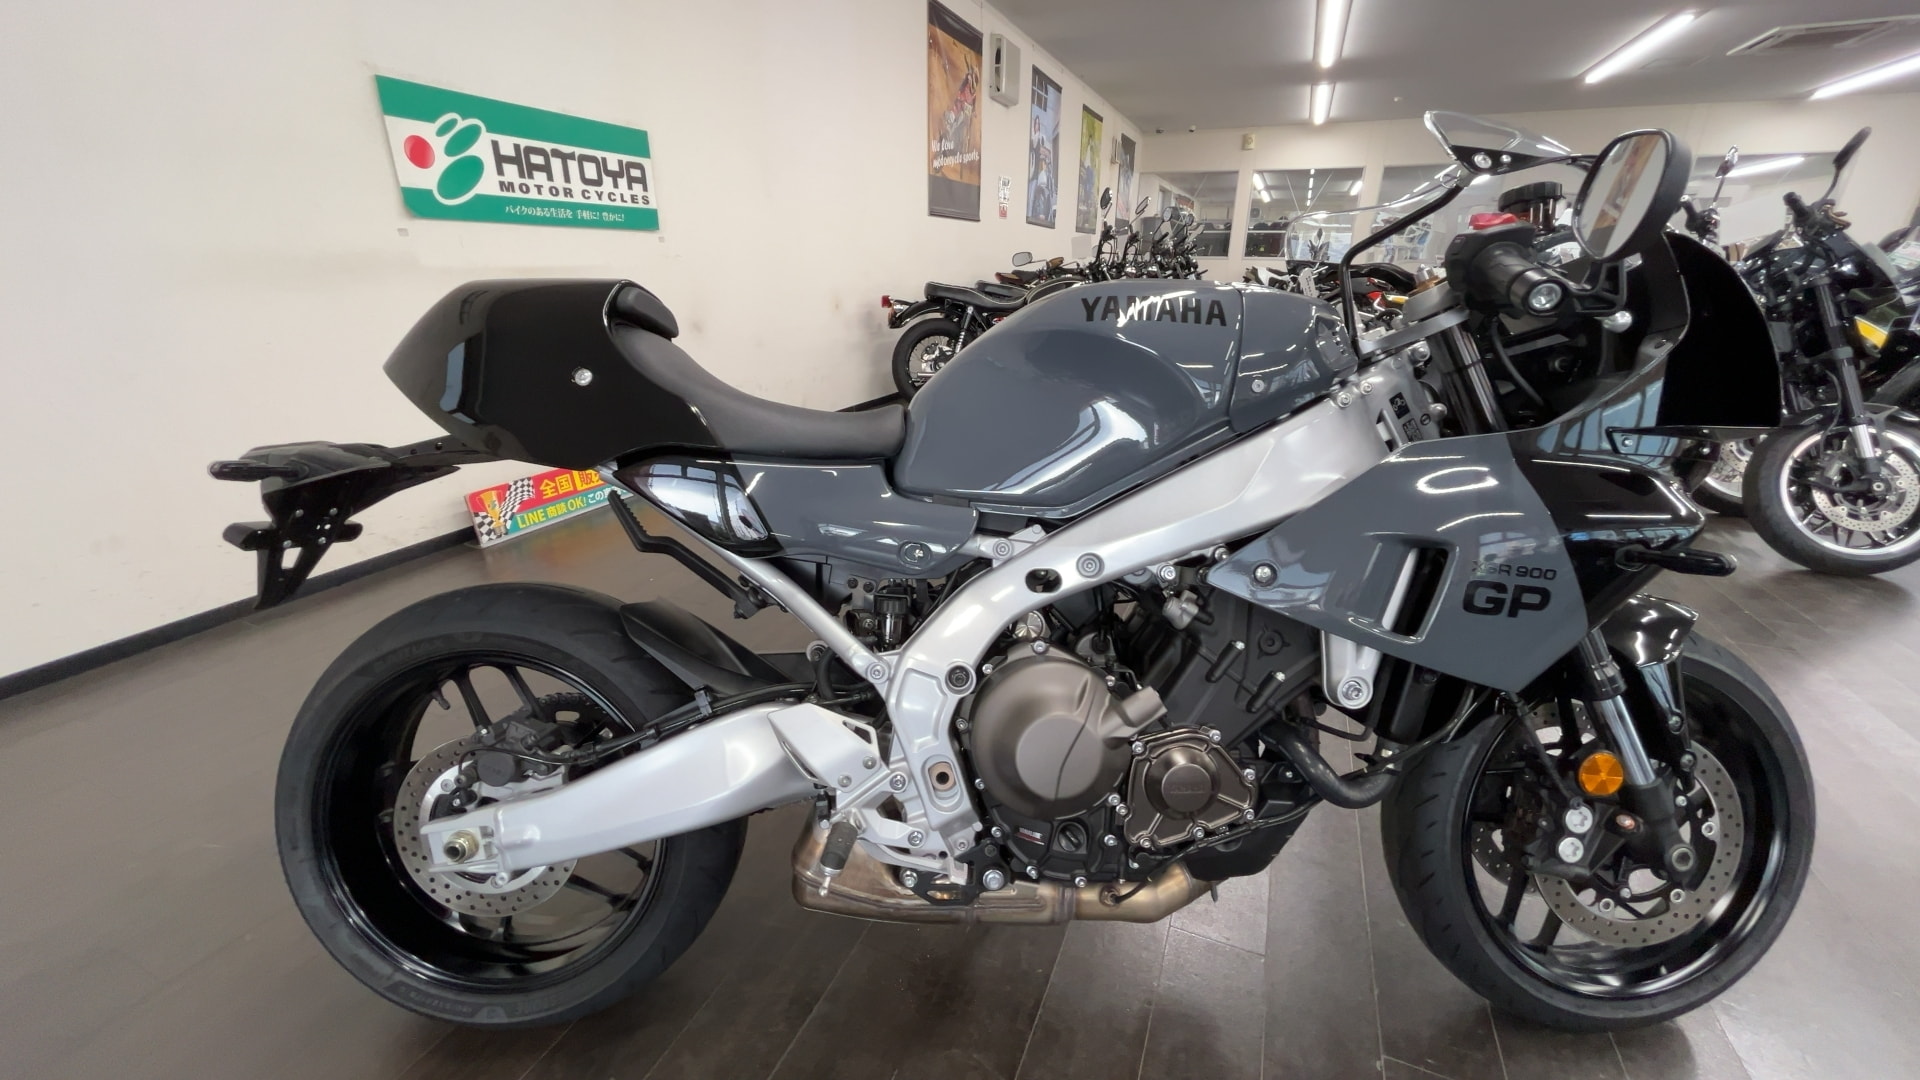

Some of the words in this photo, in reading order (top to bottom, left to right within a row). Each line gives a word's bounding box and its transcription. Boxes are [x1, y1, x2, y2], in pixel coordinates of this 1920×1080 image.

[491, 139, 649, 192] HATOYA
[498, 180, 574, 199] MOTOR
[581, 189, 650, 205] CYCLES
[505, 205, 573, 219] バイクのある生活を
[1081, 295, 1228, 327] YAMAHA
[540, 474, 574, 499] 全国
[516, 508, 547, 529] LINE
[1516, 565, 1557, 581] 900
[1462, 580, 1552, 618] GP
